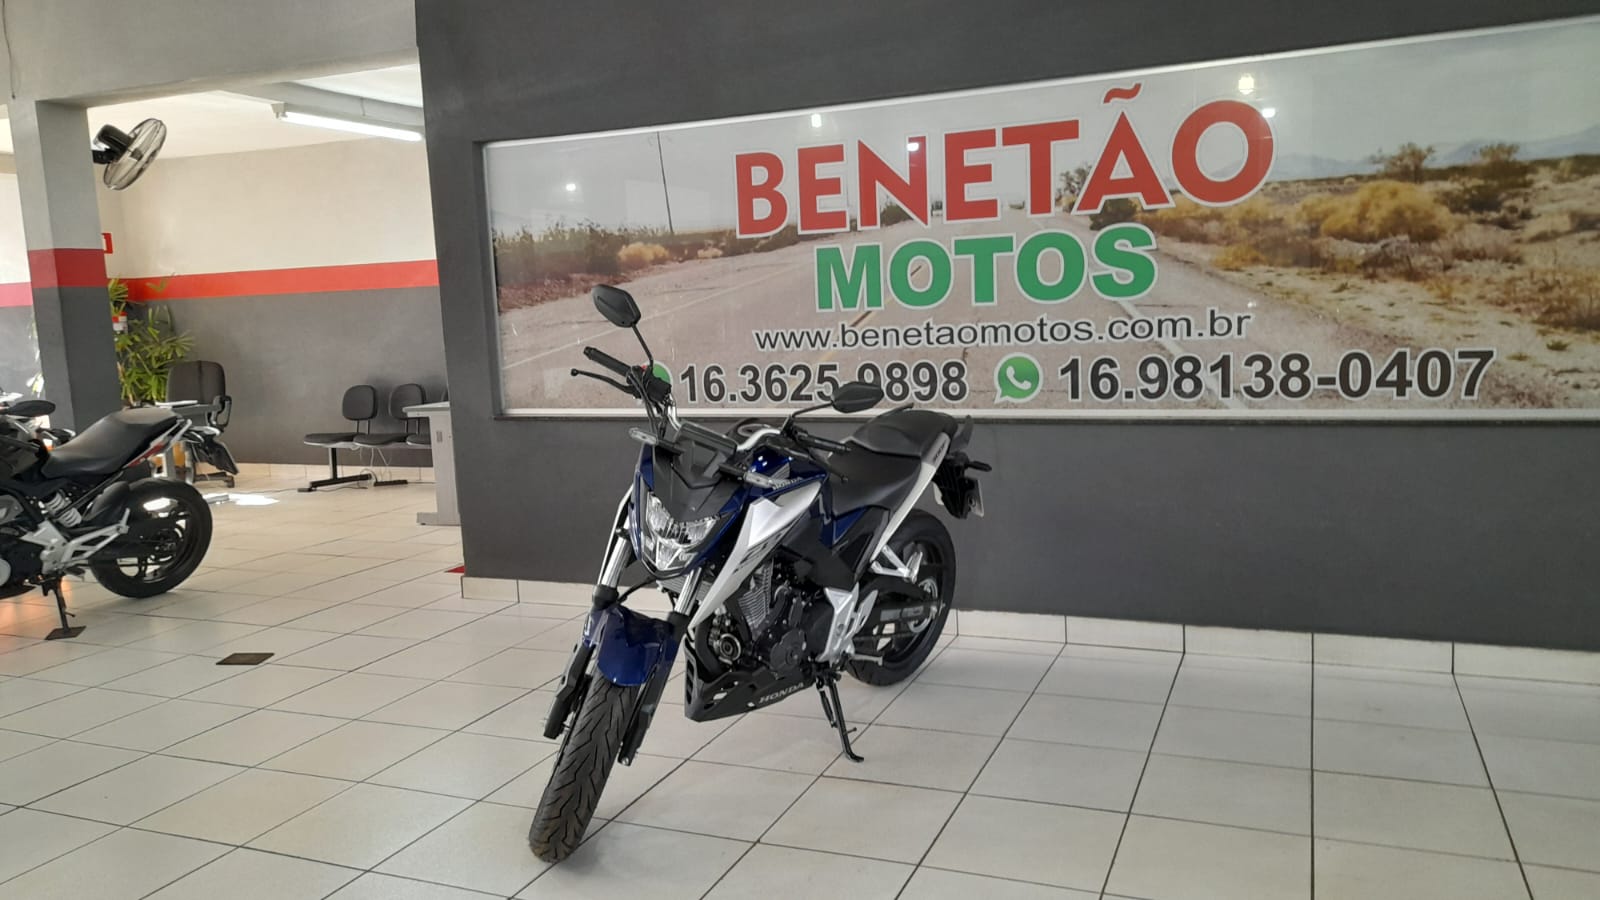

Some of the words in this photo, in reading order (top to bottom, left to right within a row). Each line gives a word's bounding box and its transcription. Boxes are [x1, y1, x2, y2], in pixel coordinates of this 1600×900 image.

[735, 83, 1273, 235] BENETÃO
[816, 225, 1157, 310] MOTOS
[756, 310, 1250, 348] www.benetaomotos.com.br
[681, 362, 966, 402] 16.36259898
[1060, 350, 1494, 400] 16.98138-0407
[759, 682, 804, 704] HONDA
